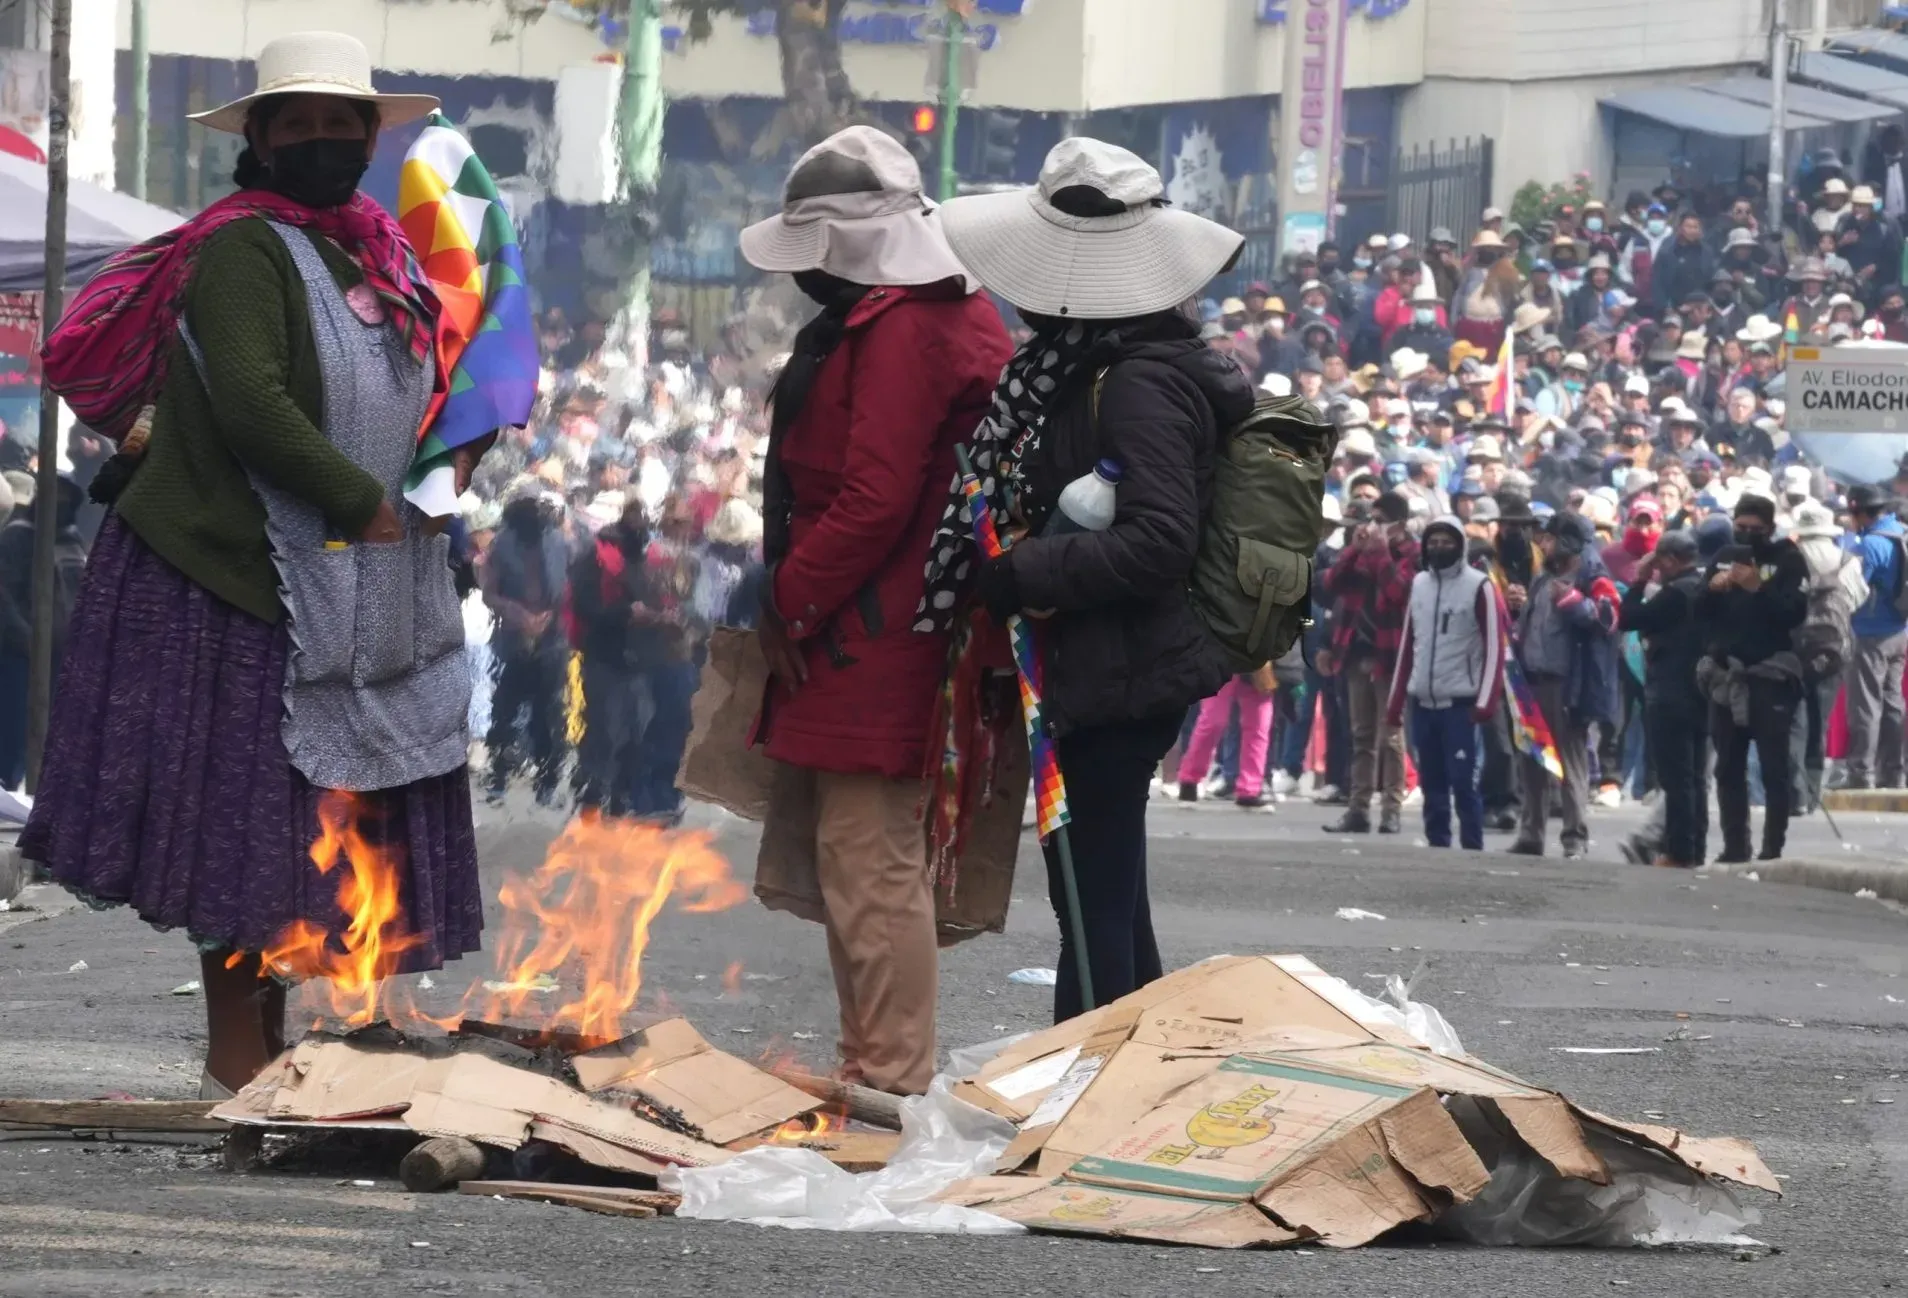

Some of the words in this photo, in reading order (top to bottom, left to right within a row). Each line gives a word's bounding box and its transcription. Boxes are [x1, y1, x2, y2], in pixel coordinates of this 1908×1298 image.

[1300, 0, 1329, 148] OBELIS
[1802, 370, 1826, 386] AV.
[1832, 369, 1908, 387] Eliodor
[1802, 389, 1908, 411] CAMACH
